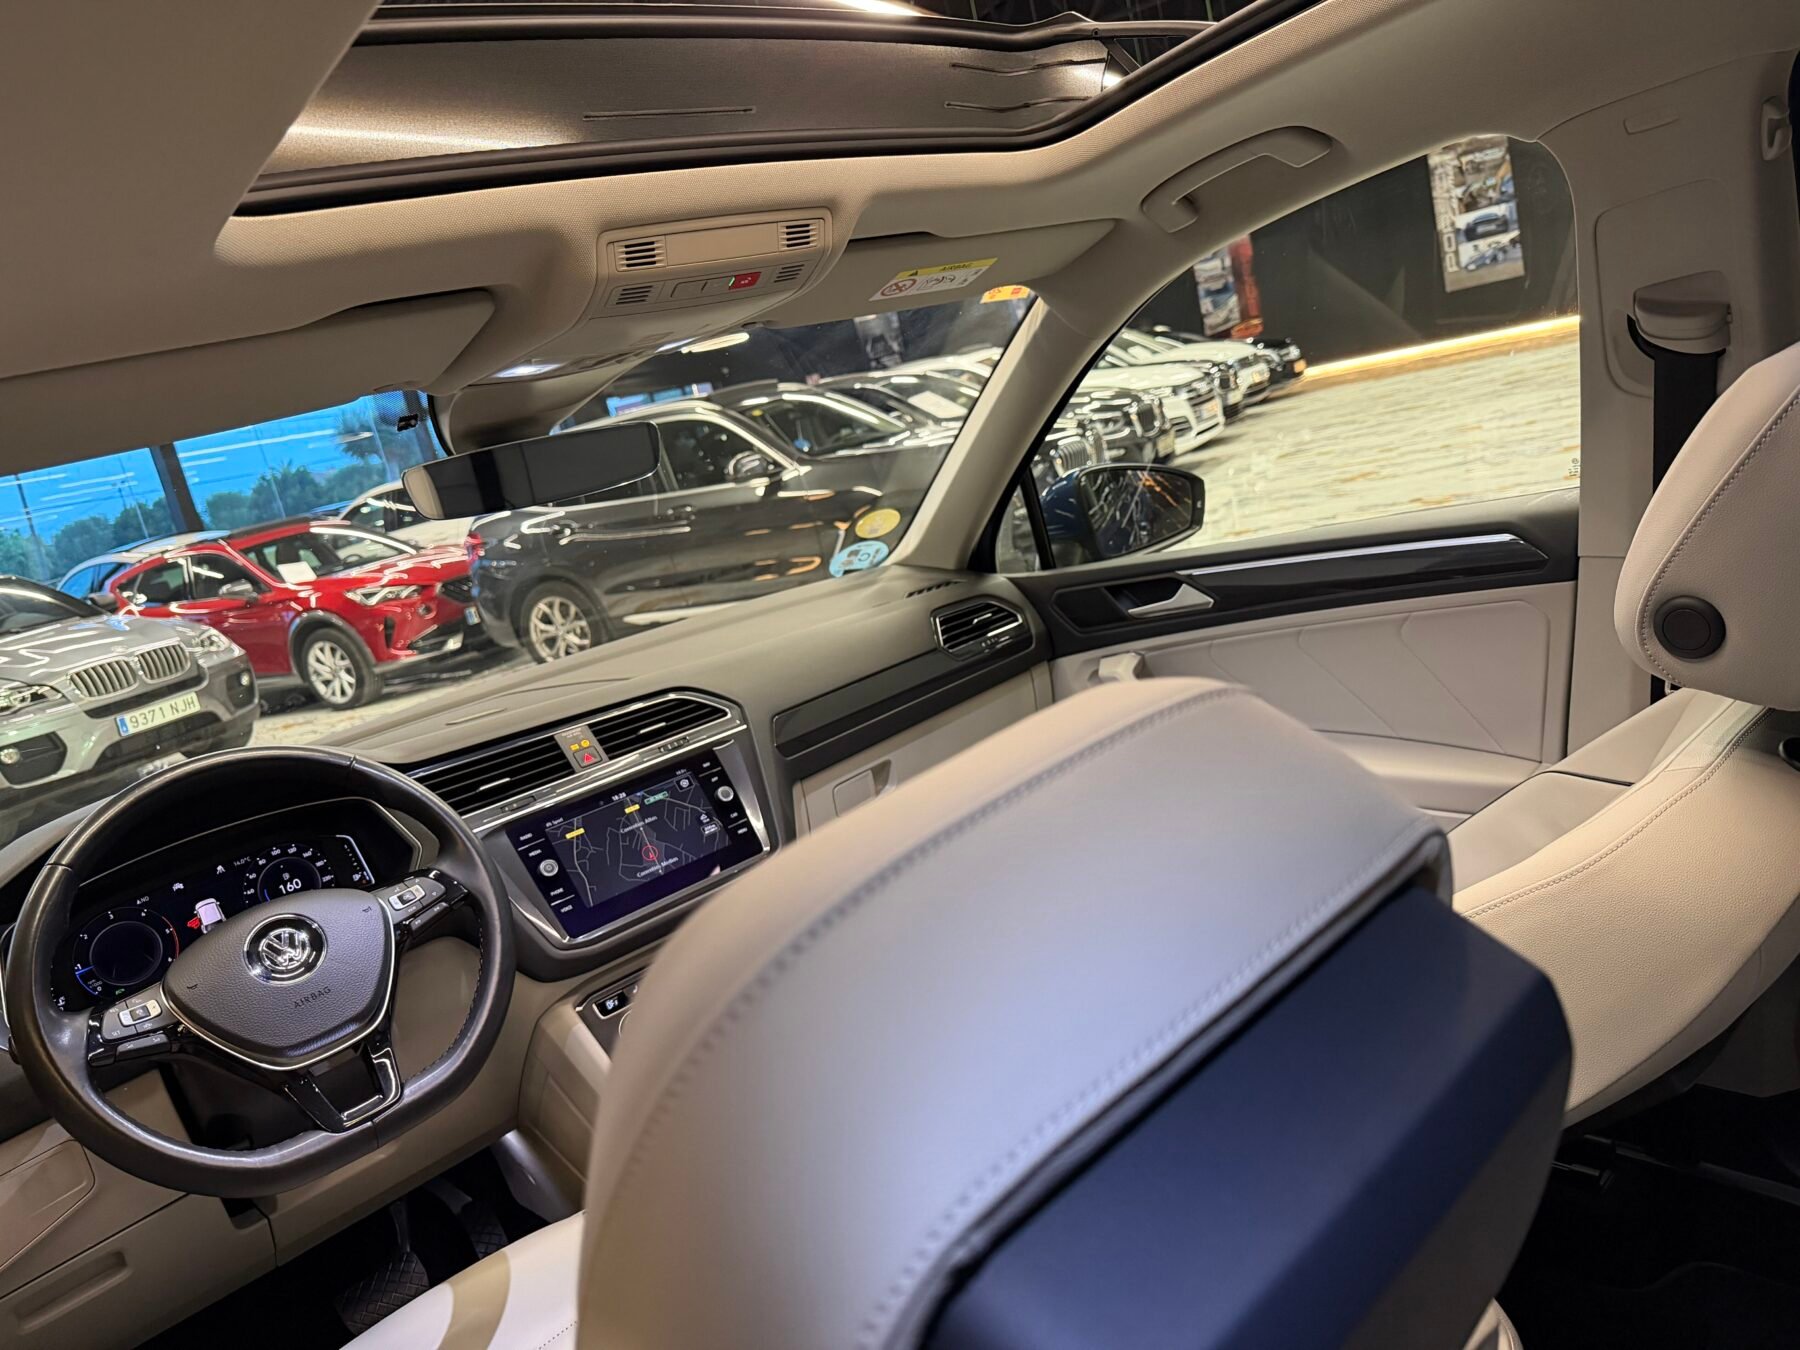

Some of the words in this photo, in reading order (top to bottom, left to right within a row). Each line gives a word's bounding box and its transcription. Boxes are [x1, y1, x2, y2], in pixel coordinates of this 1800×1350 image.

[129, 706, 165, 728] 9371
[169, 695, 196, 716] NJH
[279, 878, 301, 895] 160
[294, 986, 331, 1008] AIRBAG
